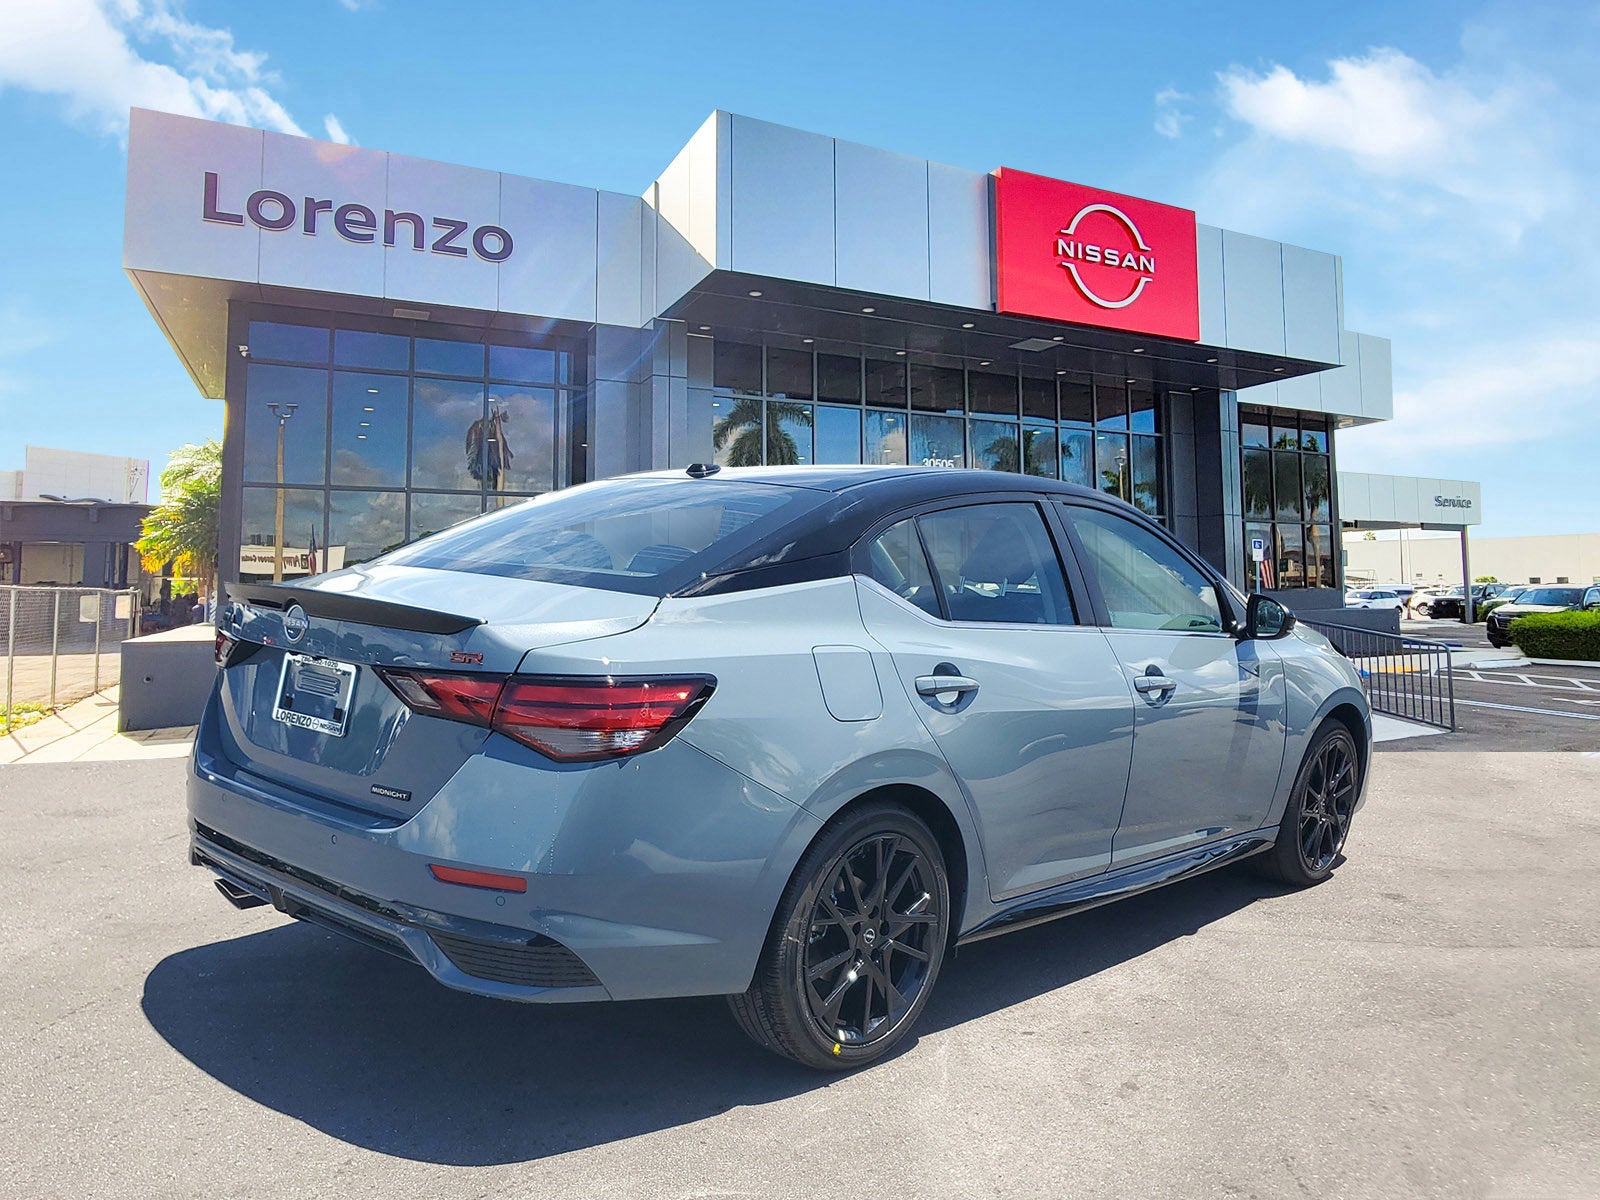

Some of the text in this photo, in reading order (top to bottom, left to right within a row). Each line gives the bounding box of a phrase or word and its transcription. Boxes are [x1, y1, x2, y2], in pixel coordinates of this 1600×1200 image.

[203, 171, 514, 262] Lorenzo
[1057, 238, 1155, 273] NISSAN
[1434, 495, 1472, 508] Service
[450, 651, 484, 665] SR
[275, 709, 312, 728] LORENZO
[371, 786, 408, 799] MIDNIGHT
